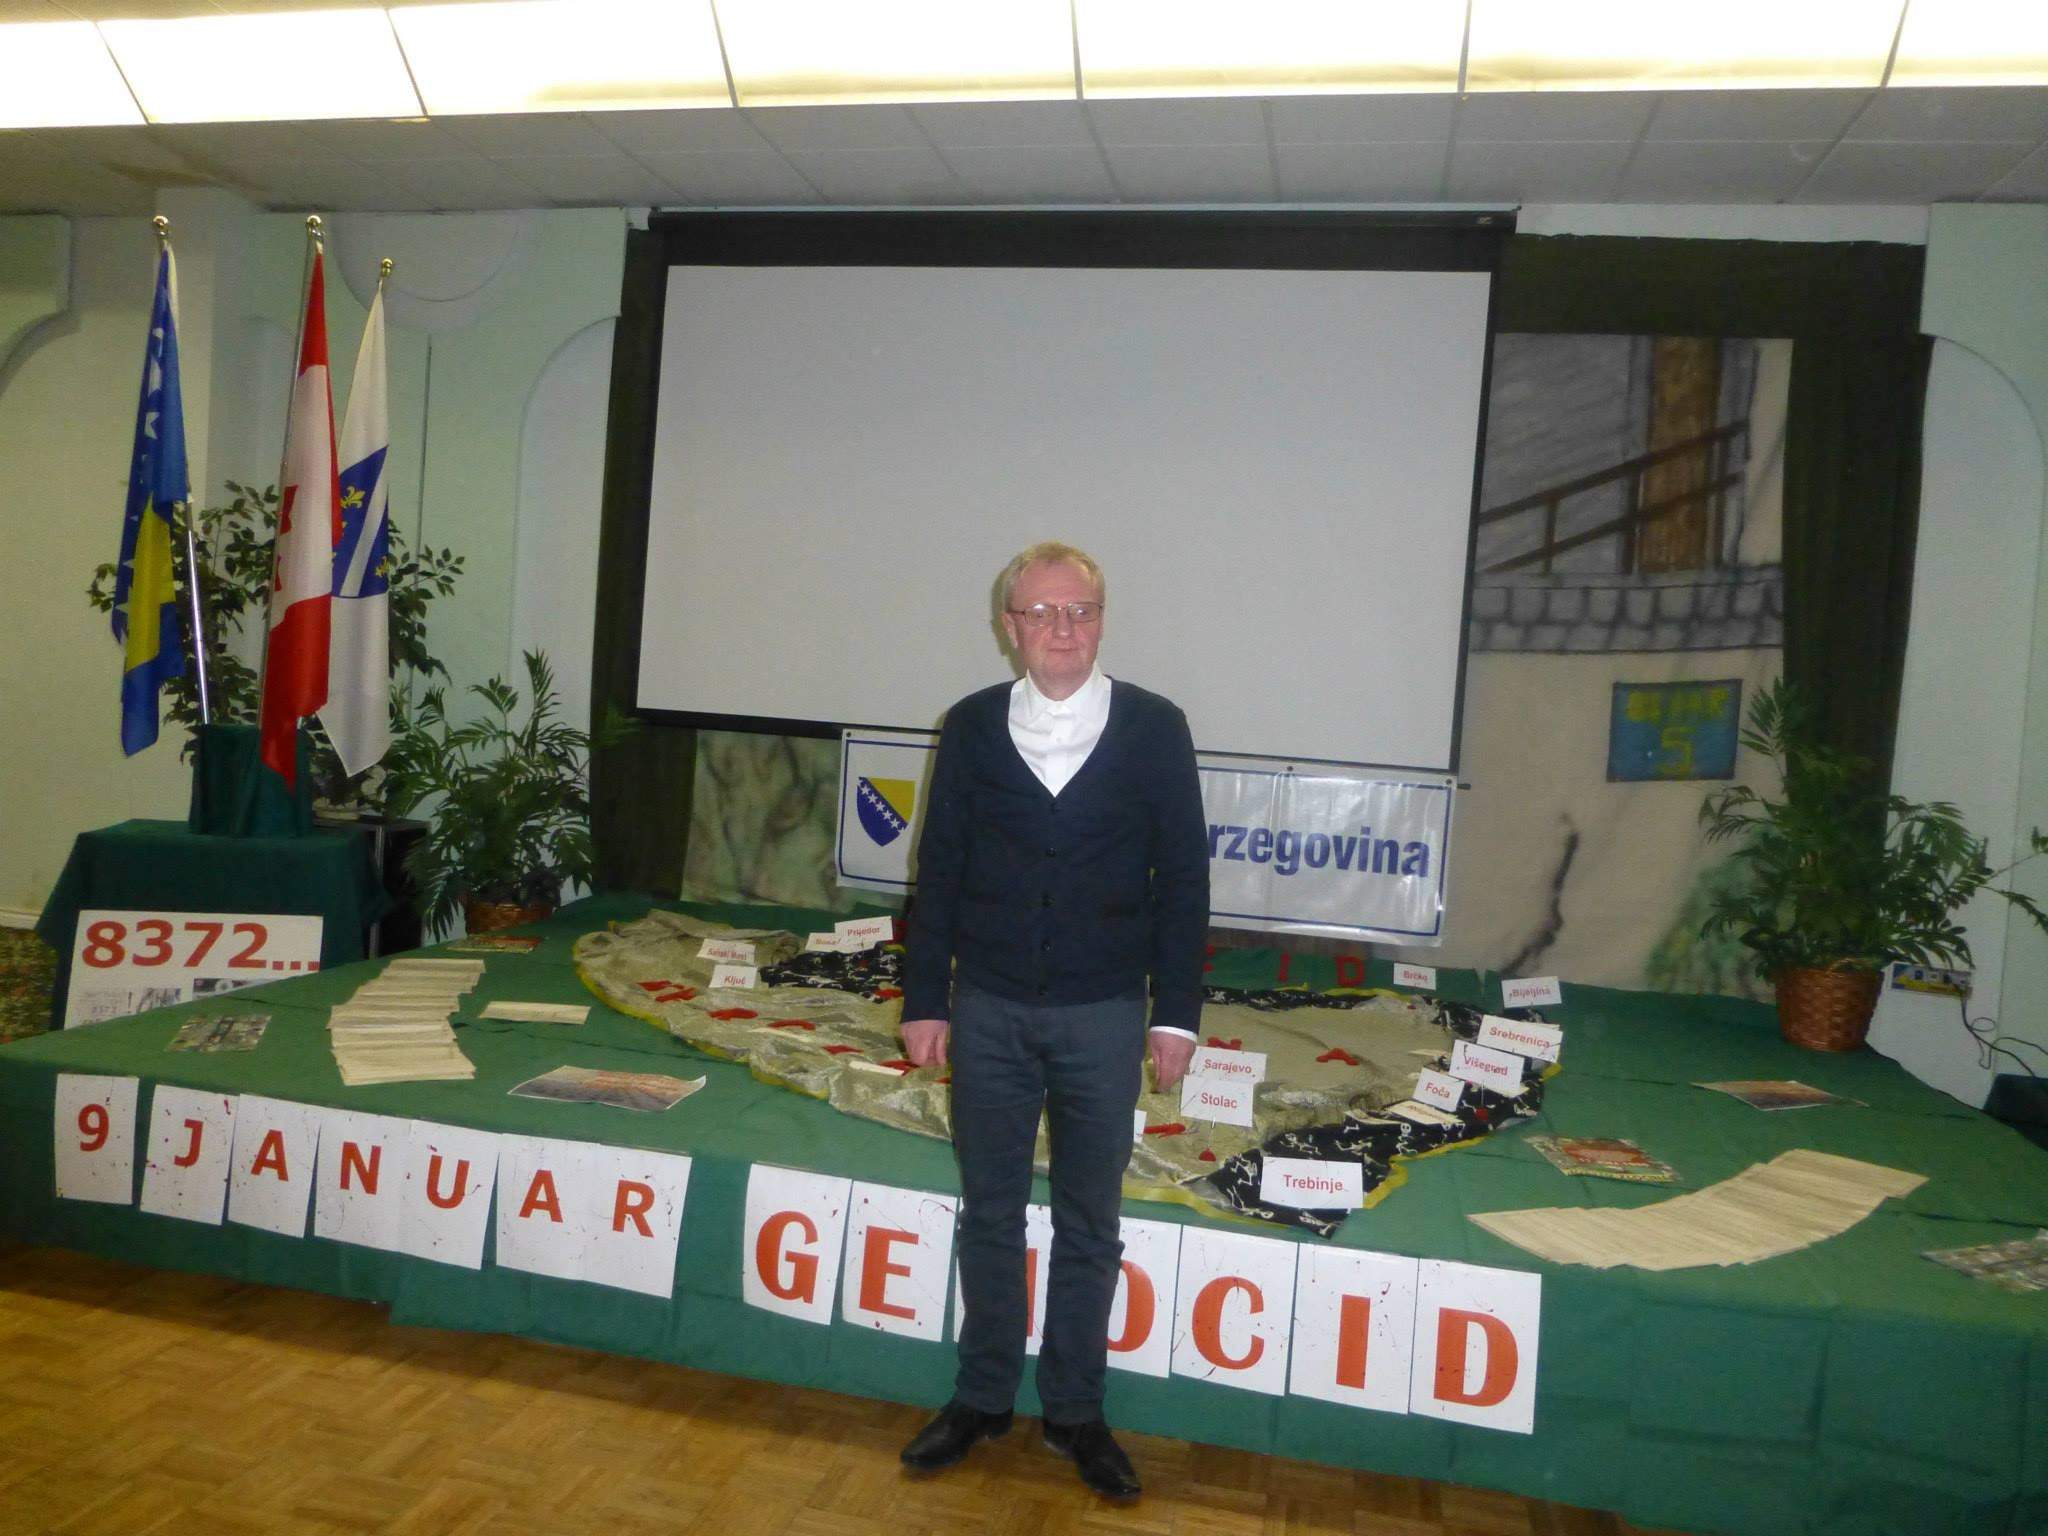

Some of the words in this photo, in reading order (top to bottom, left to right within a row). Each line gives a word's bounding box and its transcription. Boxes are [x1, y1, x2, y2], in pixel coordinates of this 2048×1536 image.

[1207, 823, 1430, 877] rzegovina
[81, 919, 320, 971] 8372...
[1488, 1026, 1551, 1049] Srebrenica
[1204, 1058, 1252, 1074] Sarajevo
[1463, 1054, 1509, 1077] Višegrad
[1200, 1092, 1238, 1110] Stolac
[1425, 1081, 1451, 1099] Foča
[77, 1103, 110, 1152] 9
[1283, 1174, 1343, 1193] Trebinje
[755, 1210, 1519, 1406] GEOCID
